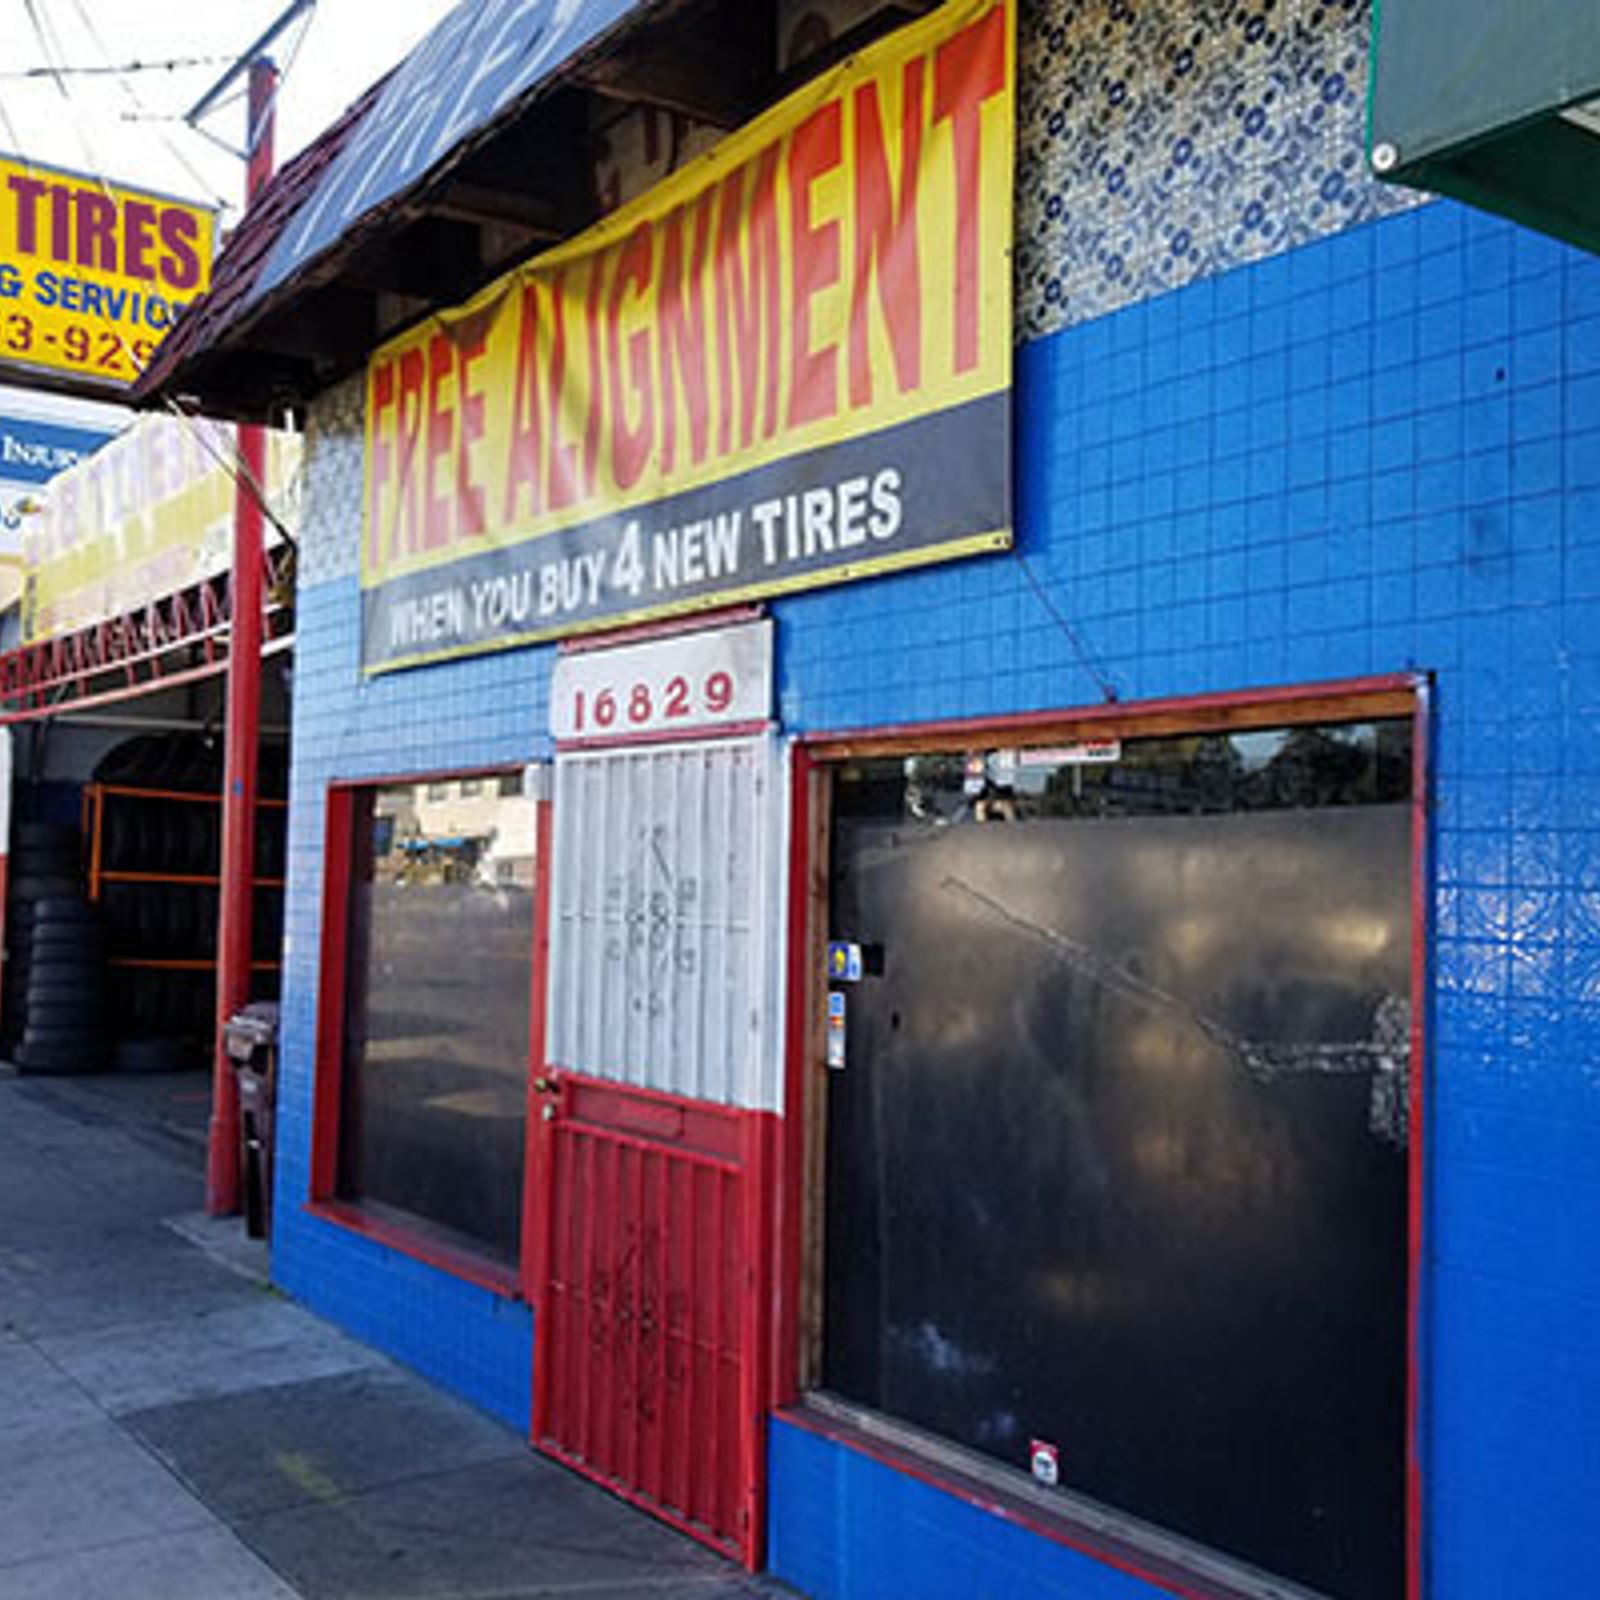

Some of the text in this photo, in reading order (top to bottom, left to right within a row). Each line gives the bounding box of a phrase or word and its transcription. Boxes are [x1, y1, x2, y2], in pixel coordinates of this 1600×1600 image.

[8, 174, 200, 290] TIRES
[368, 330, 487, 572] FREE
[503, 6, 1004, 525] ALIGNMENT
[35, 271, 188, 329] SERVIC
[390, 468, 901, 646] WHEN YOU BUY 4 NEW TIRES
[575, 671, 732, 730] 16829
